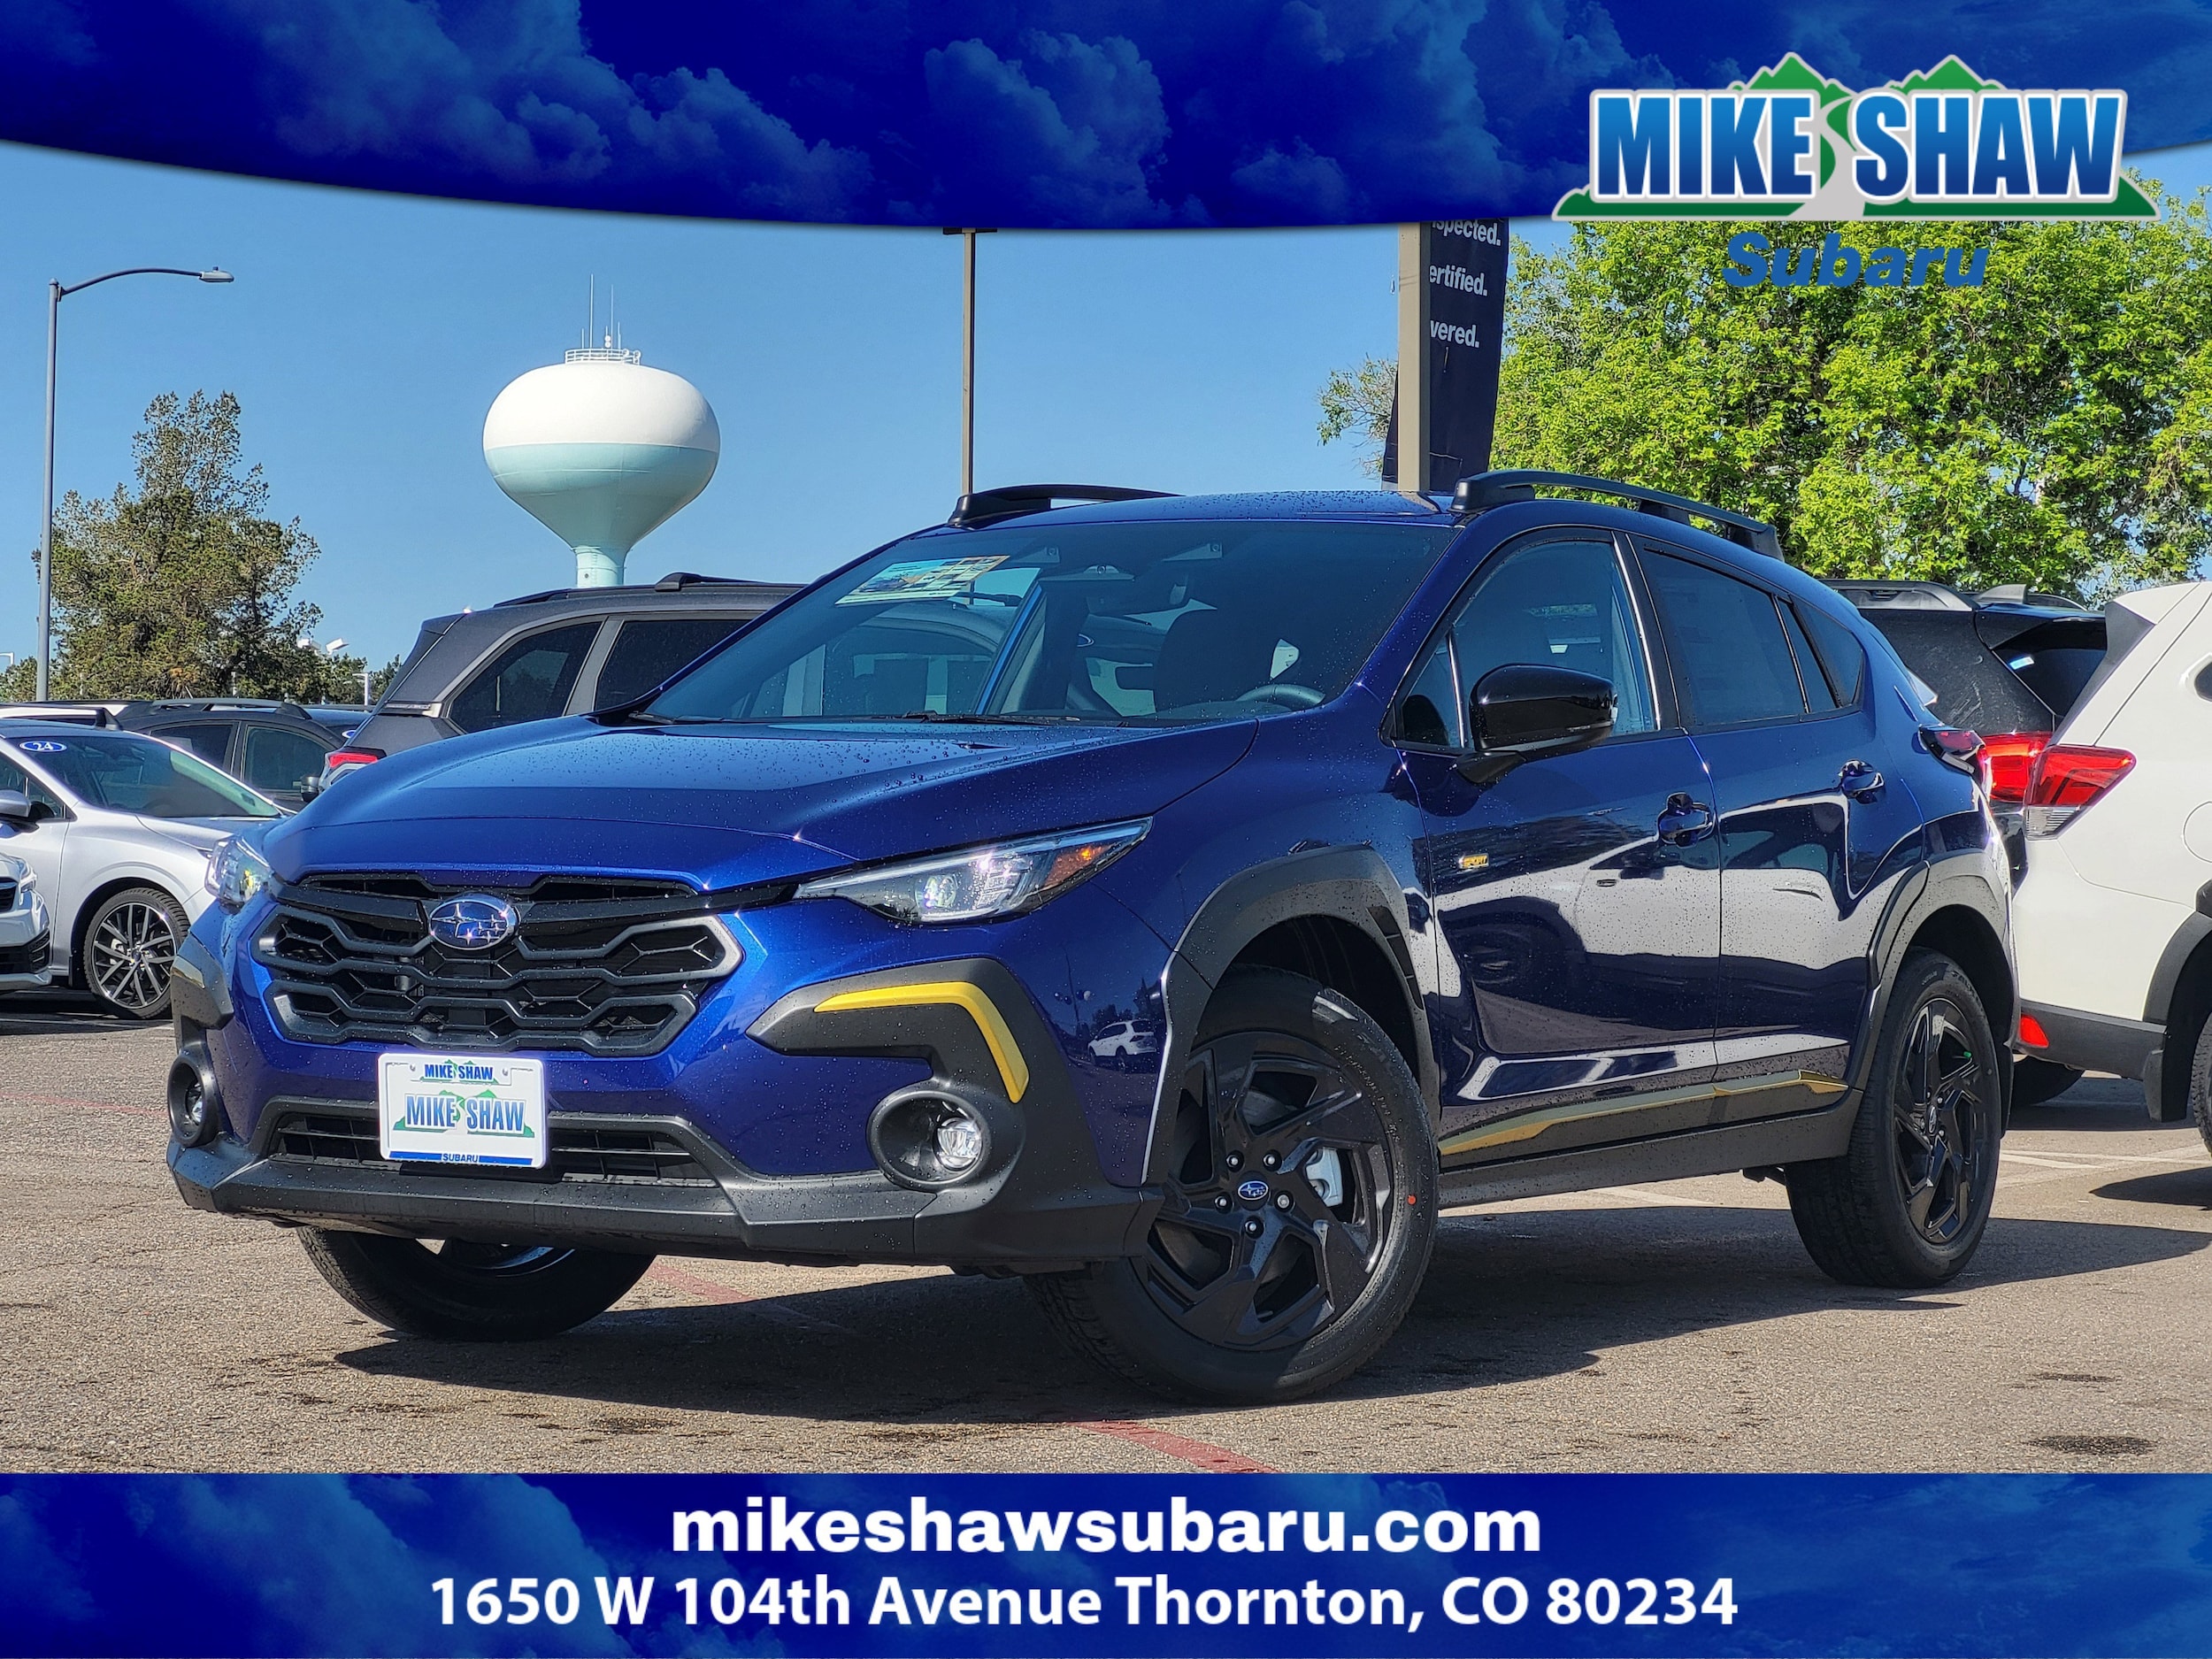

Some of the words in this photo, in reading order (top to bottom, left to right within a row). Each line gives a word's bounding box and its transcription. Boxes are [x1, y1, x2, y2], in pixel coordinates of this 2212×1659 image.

[32, 741, 54, 751] 24
[424, 1064, 453, 1079] MIKE
[457, 1064, 494, 1080] SHAW
[406, 1095, 456, 1128] MIKE
[465, 1098, 526, 1132] SHAW
[442, 1153, 480, 1164] SUBARU
